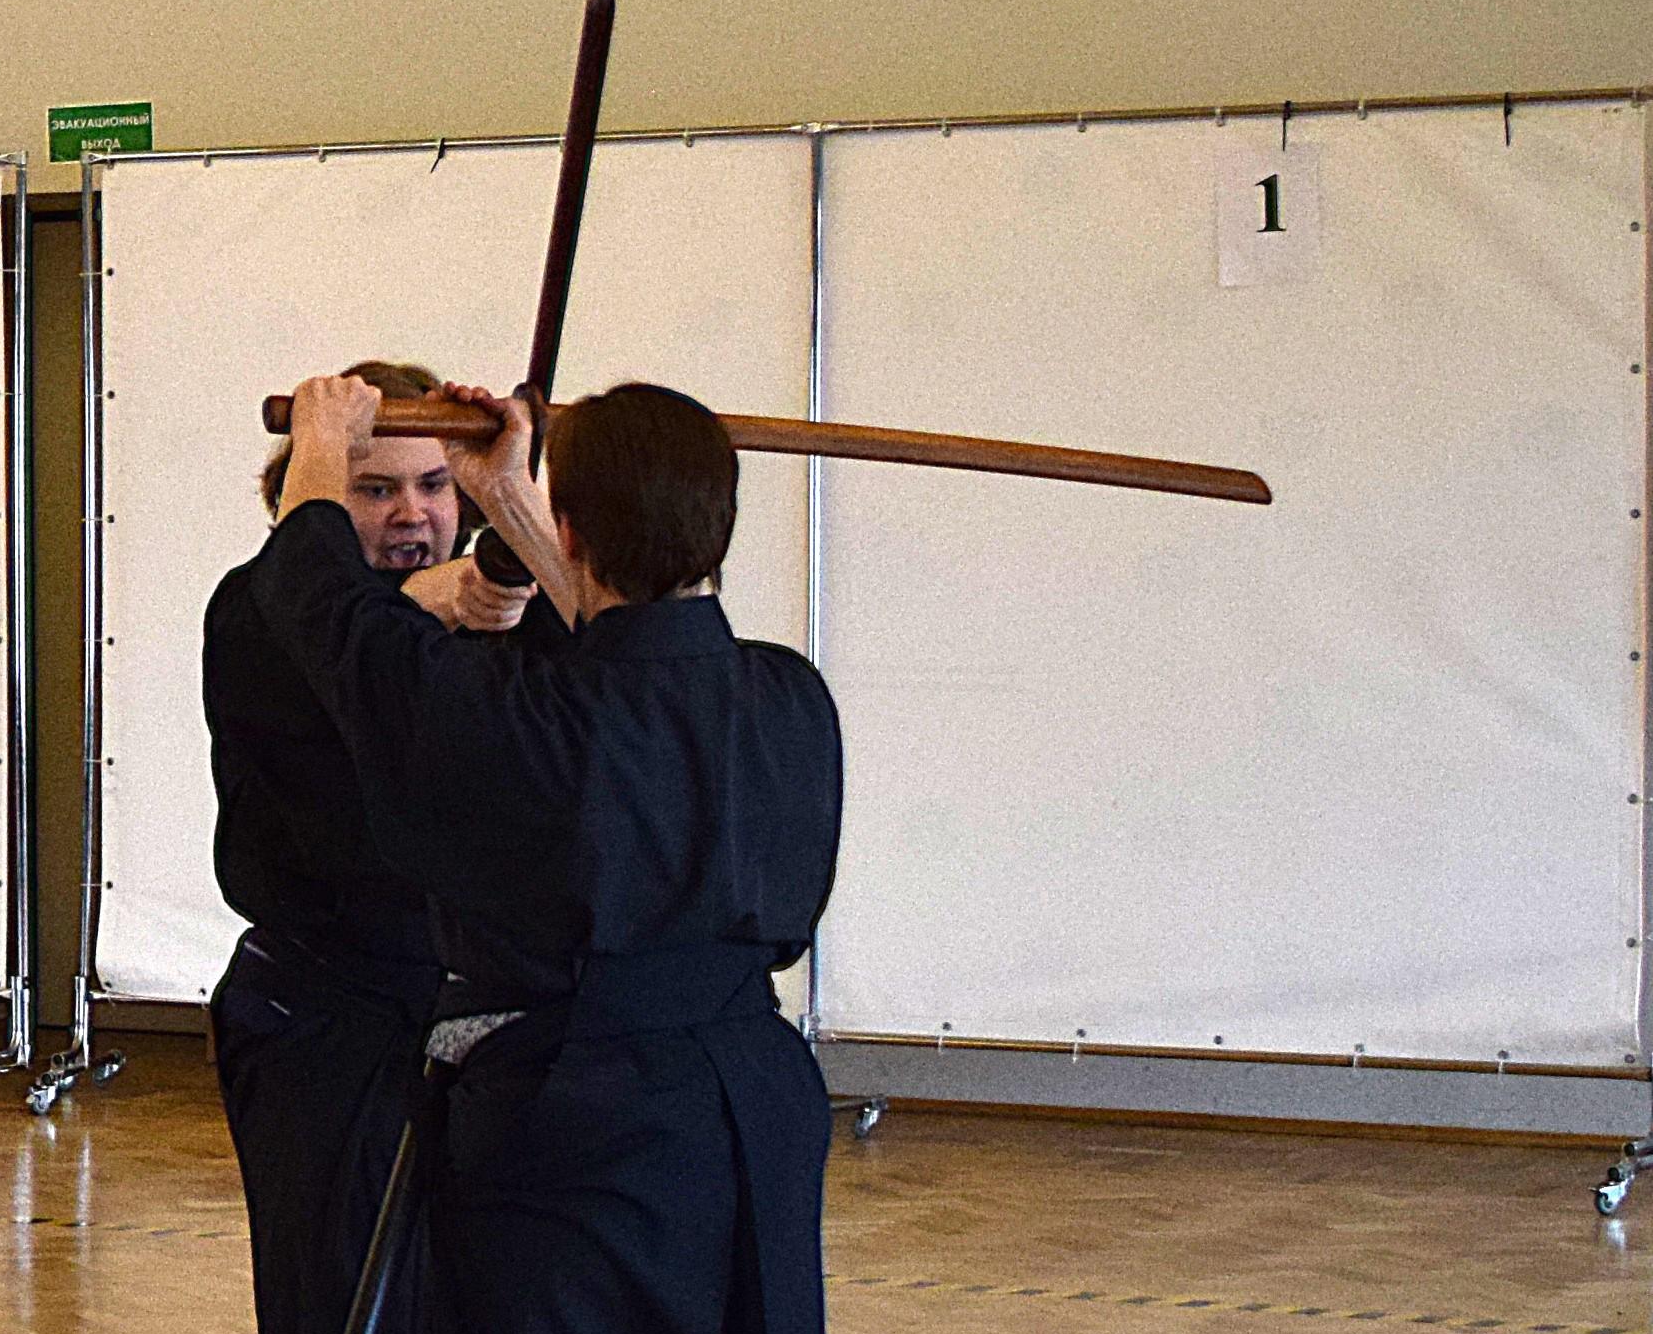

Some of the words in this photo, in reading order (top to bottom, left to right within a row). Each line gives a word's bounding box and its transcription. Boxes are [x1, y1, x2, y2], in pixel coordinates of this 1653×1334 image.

[51, 113, 149, 130] ЭВАКУАЦИОННЫЙ
[81, 138, 121, 149] ВЫХОД
[1255, 174, 1287, 232] 1
